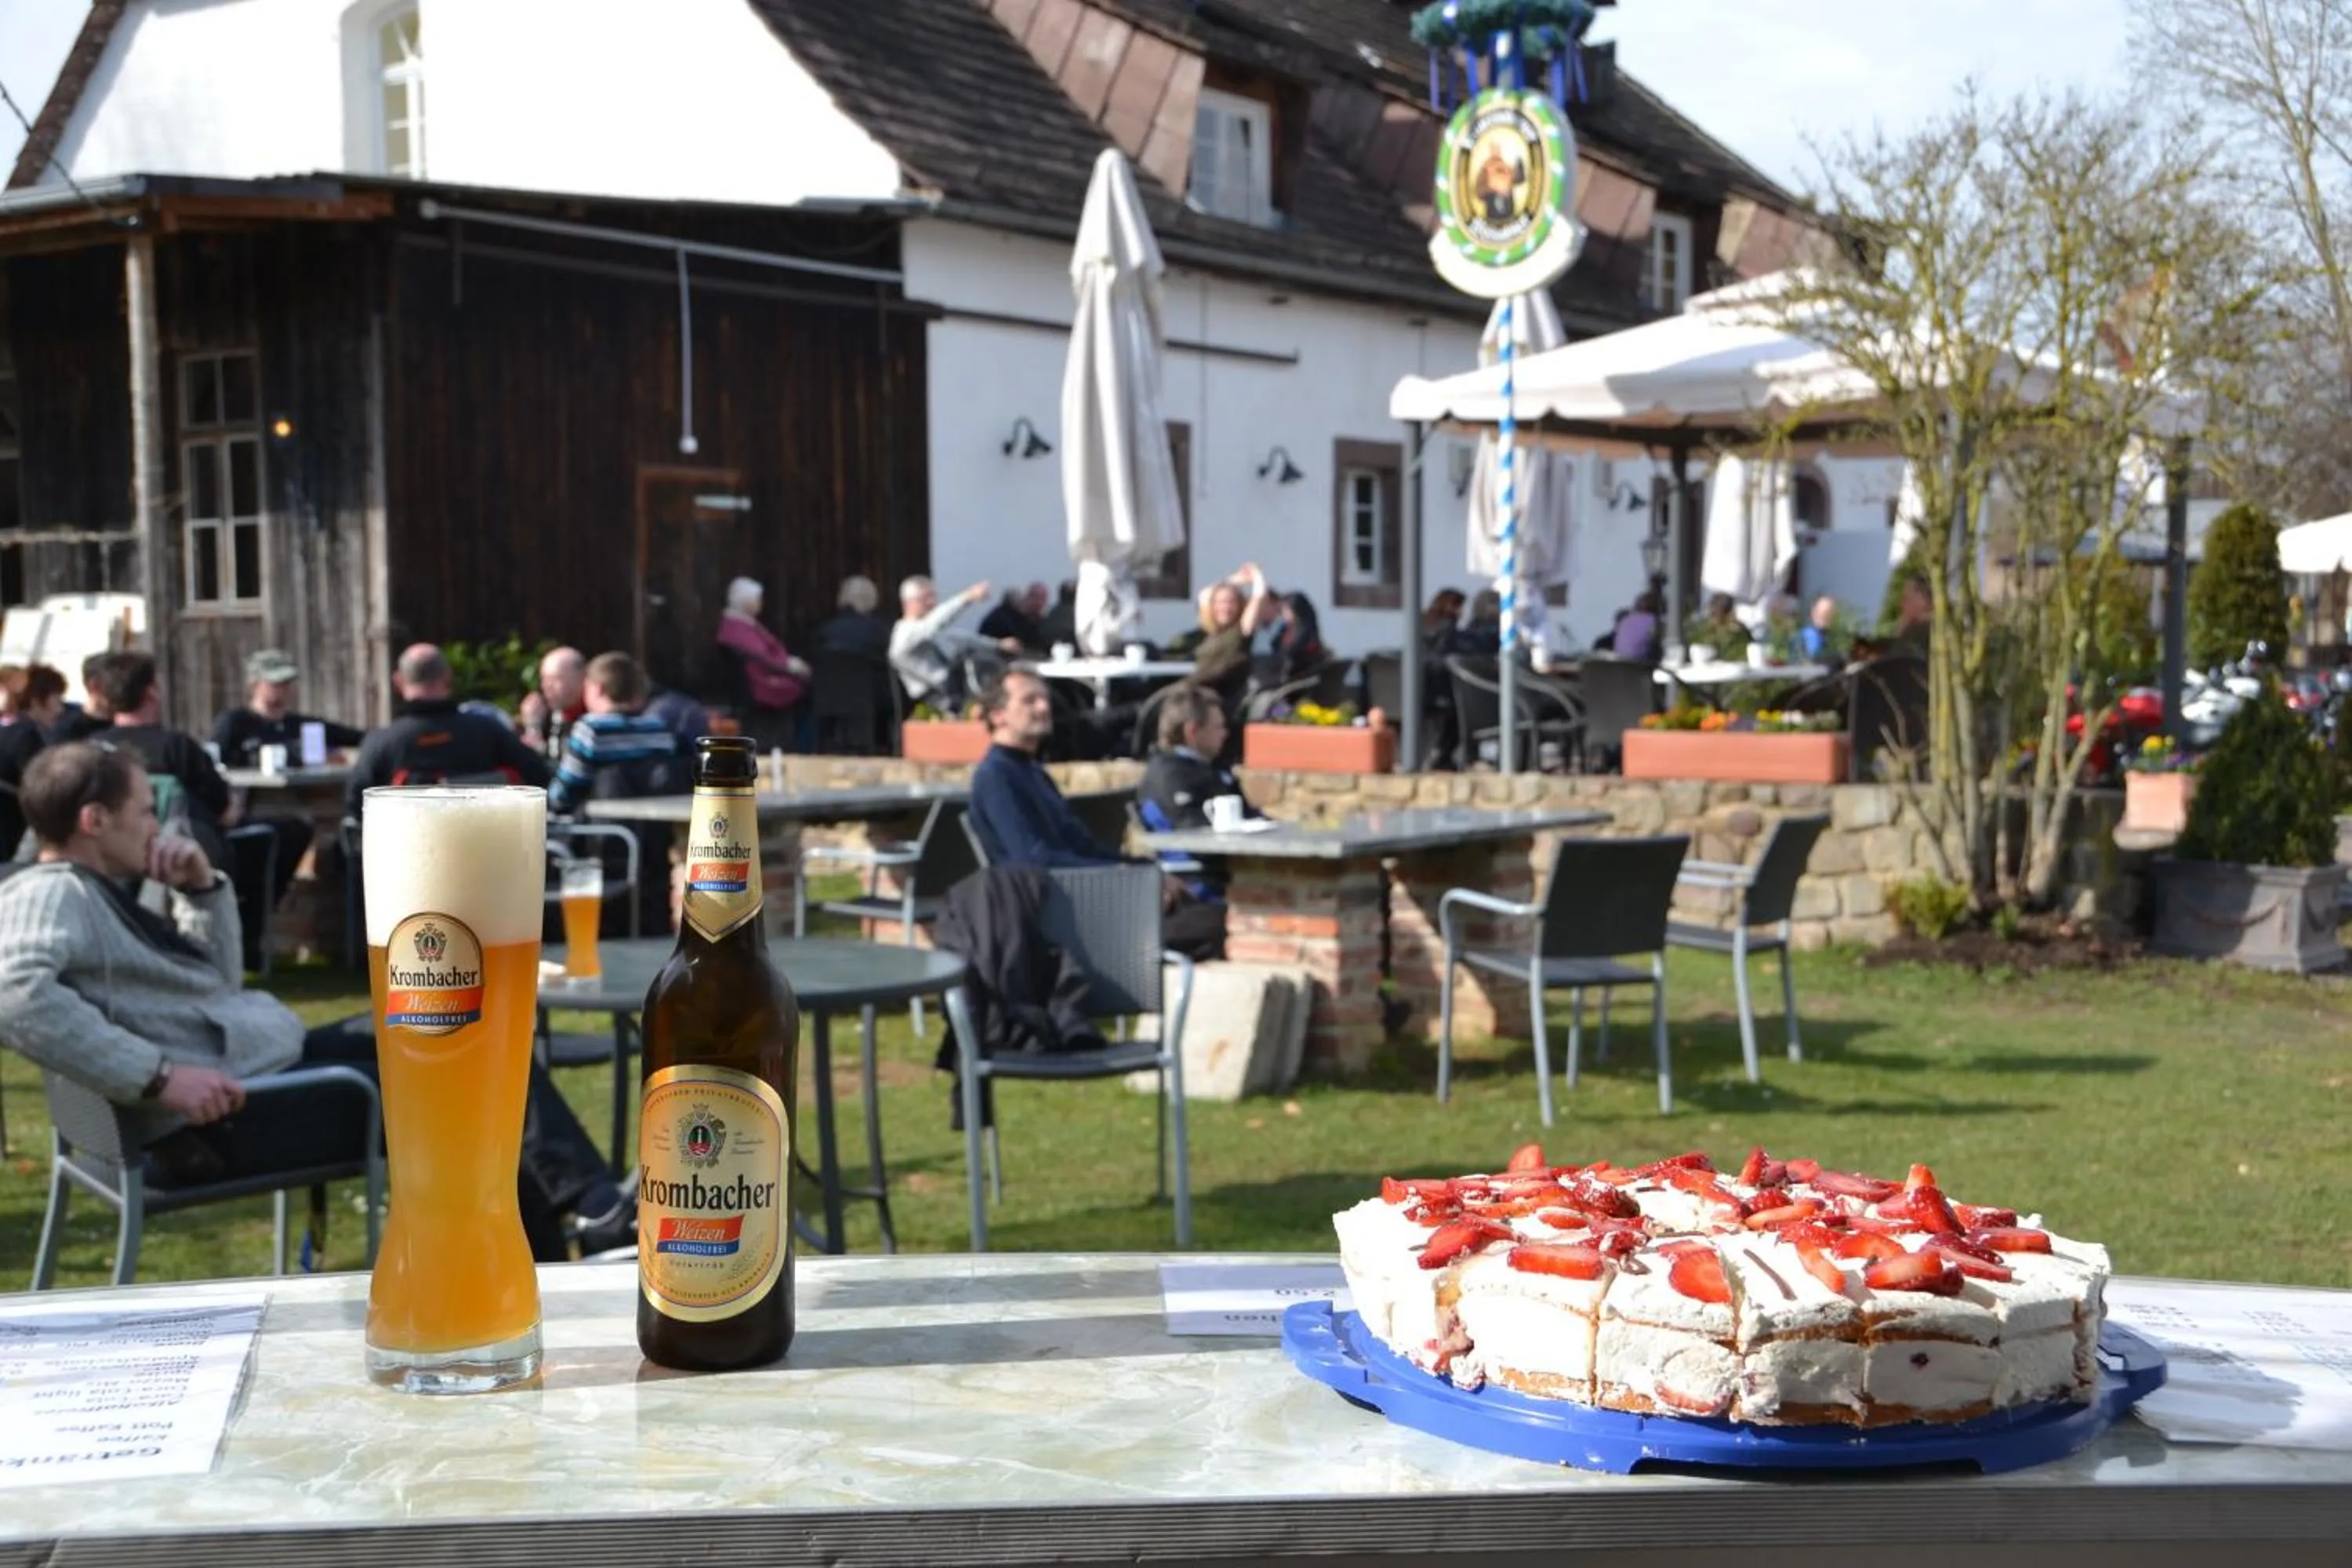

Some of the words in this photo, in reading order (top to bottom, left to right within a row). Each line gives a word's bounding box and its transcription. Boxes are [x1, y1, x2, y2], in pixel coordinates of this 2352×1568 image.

[690, 841, 751, 858] Krombacher
[390, 966, 477, 986] Krombacher
[641, 1164, 775, 1209] Krombacher
[672, 1219, 726, 1240] Weizen
[667, 1243, 727, 1254] ALKOHOLFREI
